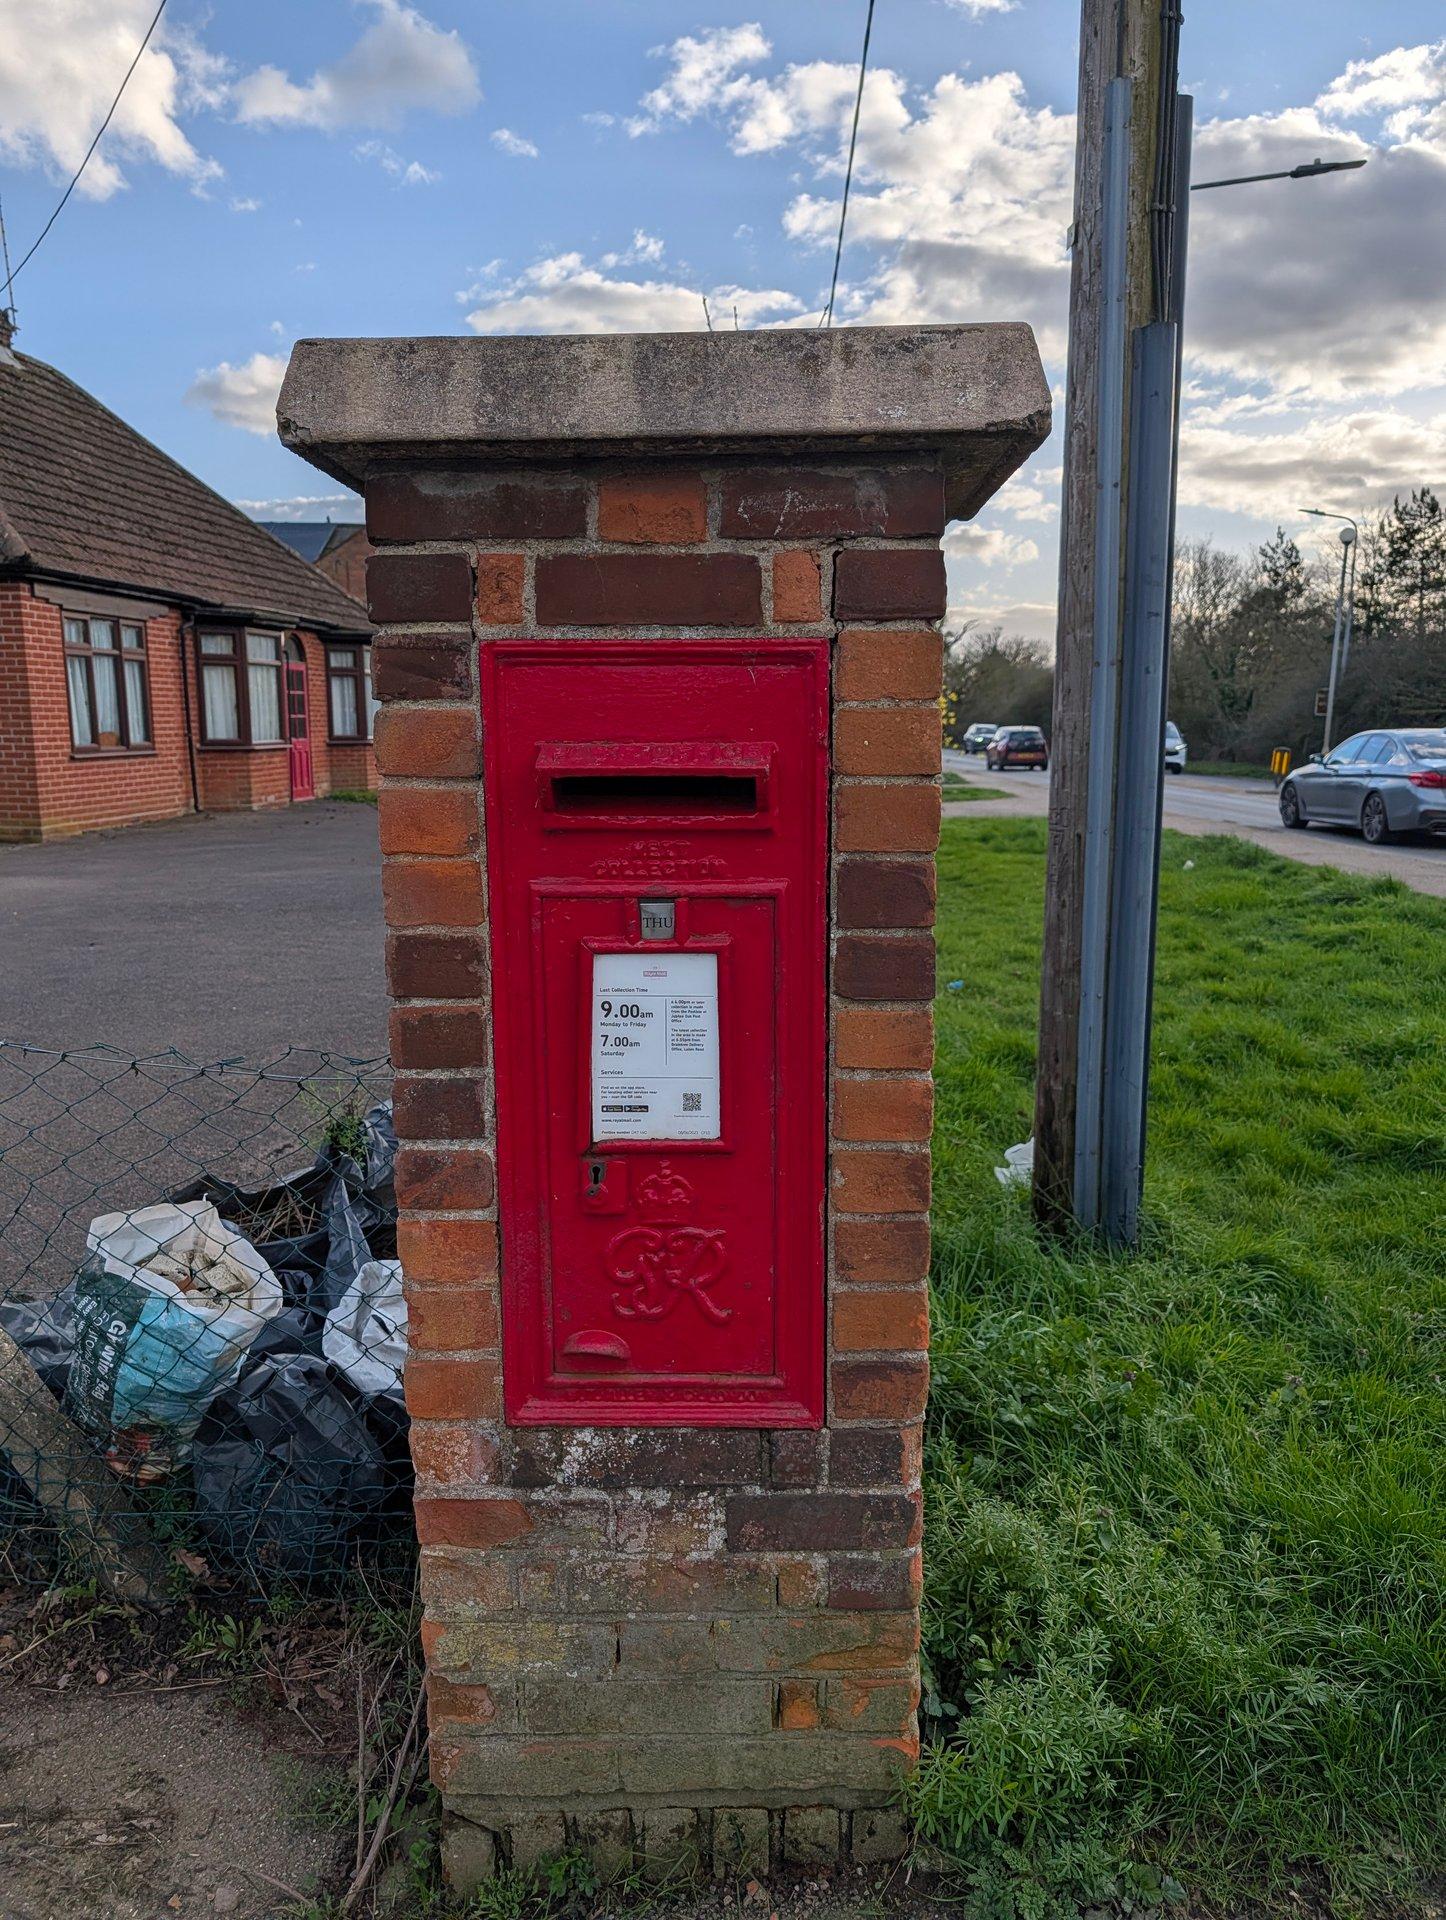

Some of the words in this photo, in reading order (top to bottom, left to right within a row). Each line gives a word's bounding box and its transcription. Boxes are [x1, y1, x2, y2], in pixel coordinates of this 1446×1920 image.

[643, 918, 673, 928] THU
[601, 1000, 654, 1018] 9.00am
[601, 1034, 640, 1047] 7.00am
